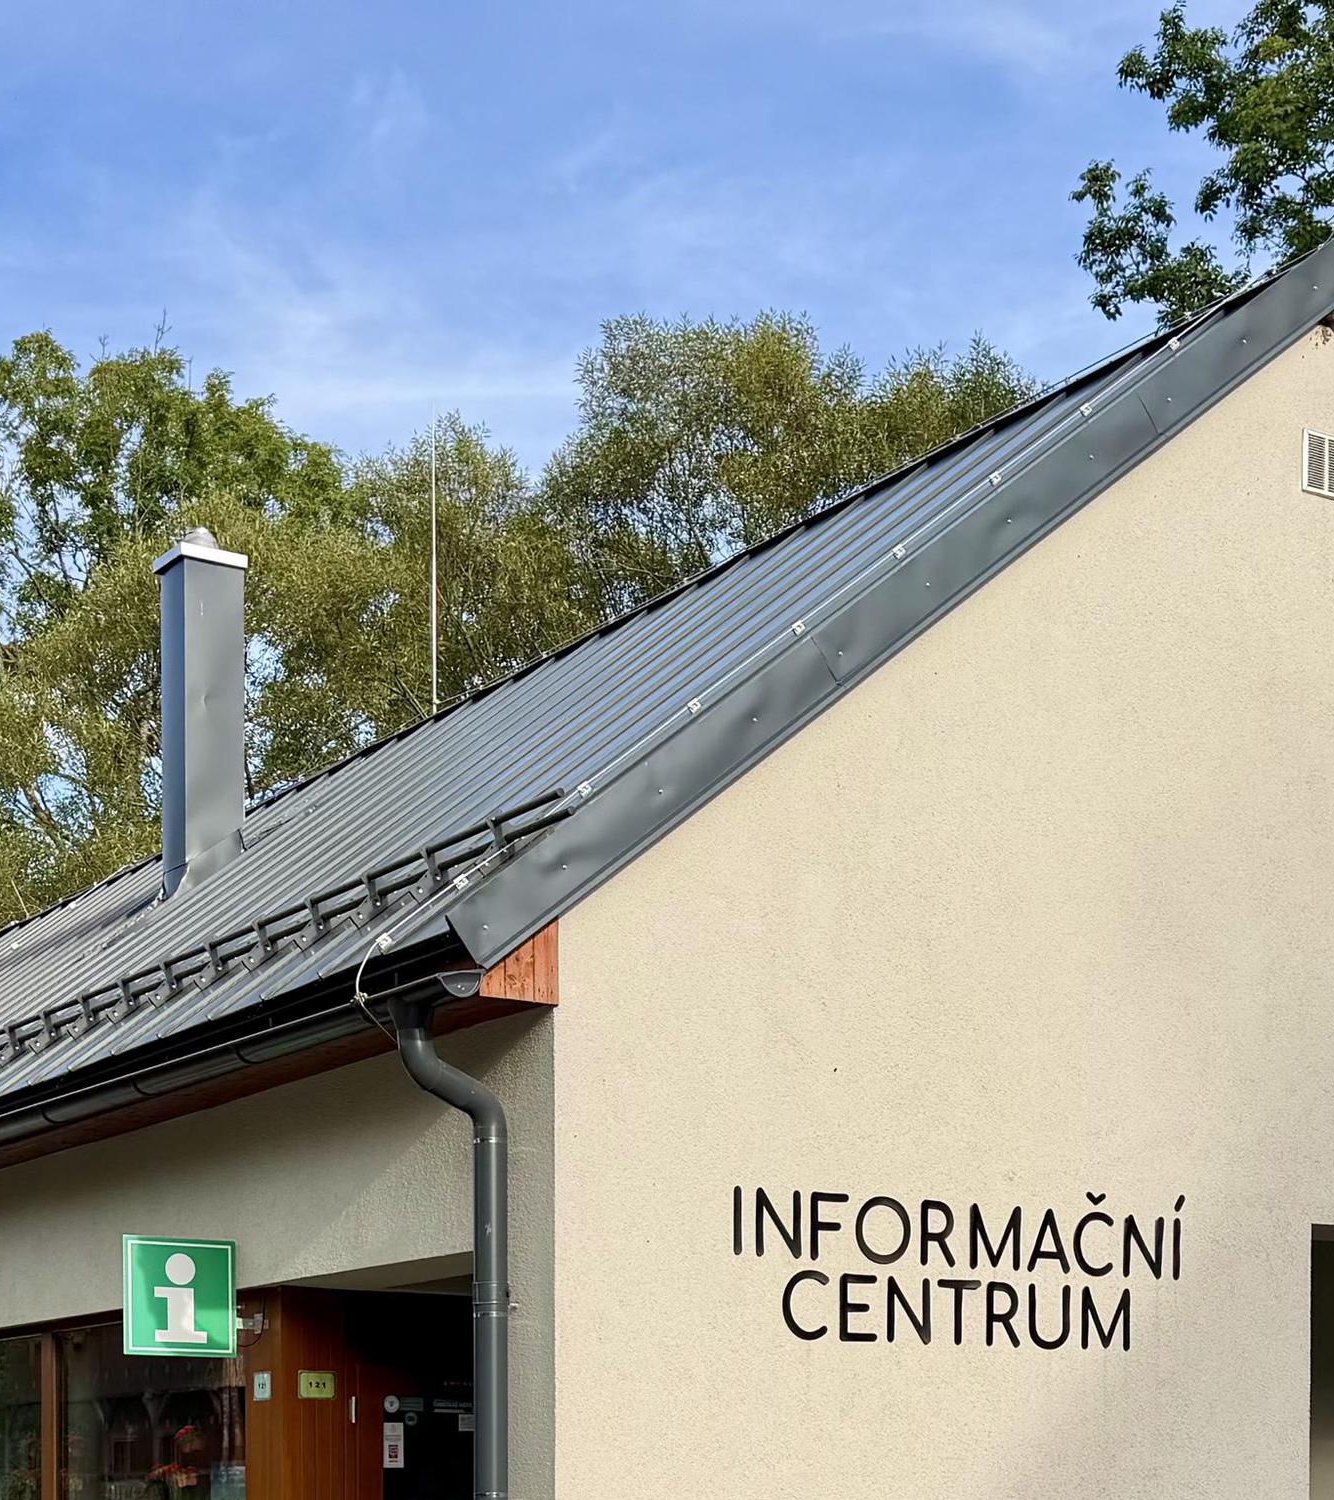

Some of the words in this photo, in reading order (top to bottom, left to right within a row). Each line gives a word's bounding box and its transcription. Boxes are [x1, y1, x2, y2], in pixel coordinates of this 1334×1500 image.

[732, 1185, 1186, 1281] INFORMAČNÍ
[782, 1269, 1132, 1351] CENTRUM
[308, 1381, 326, 1389] 121
